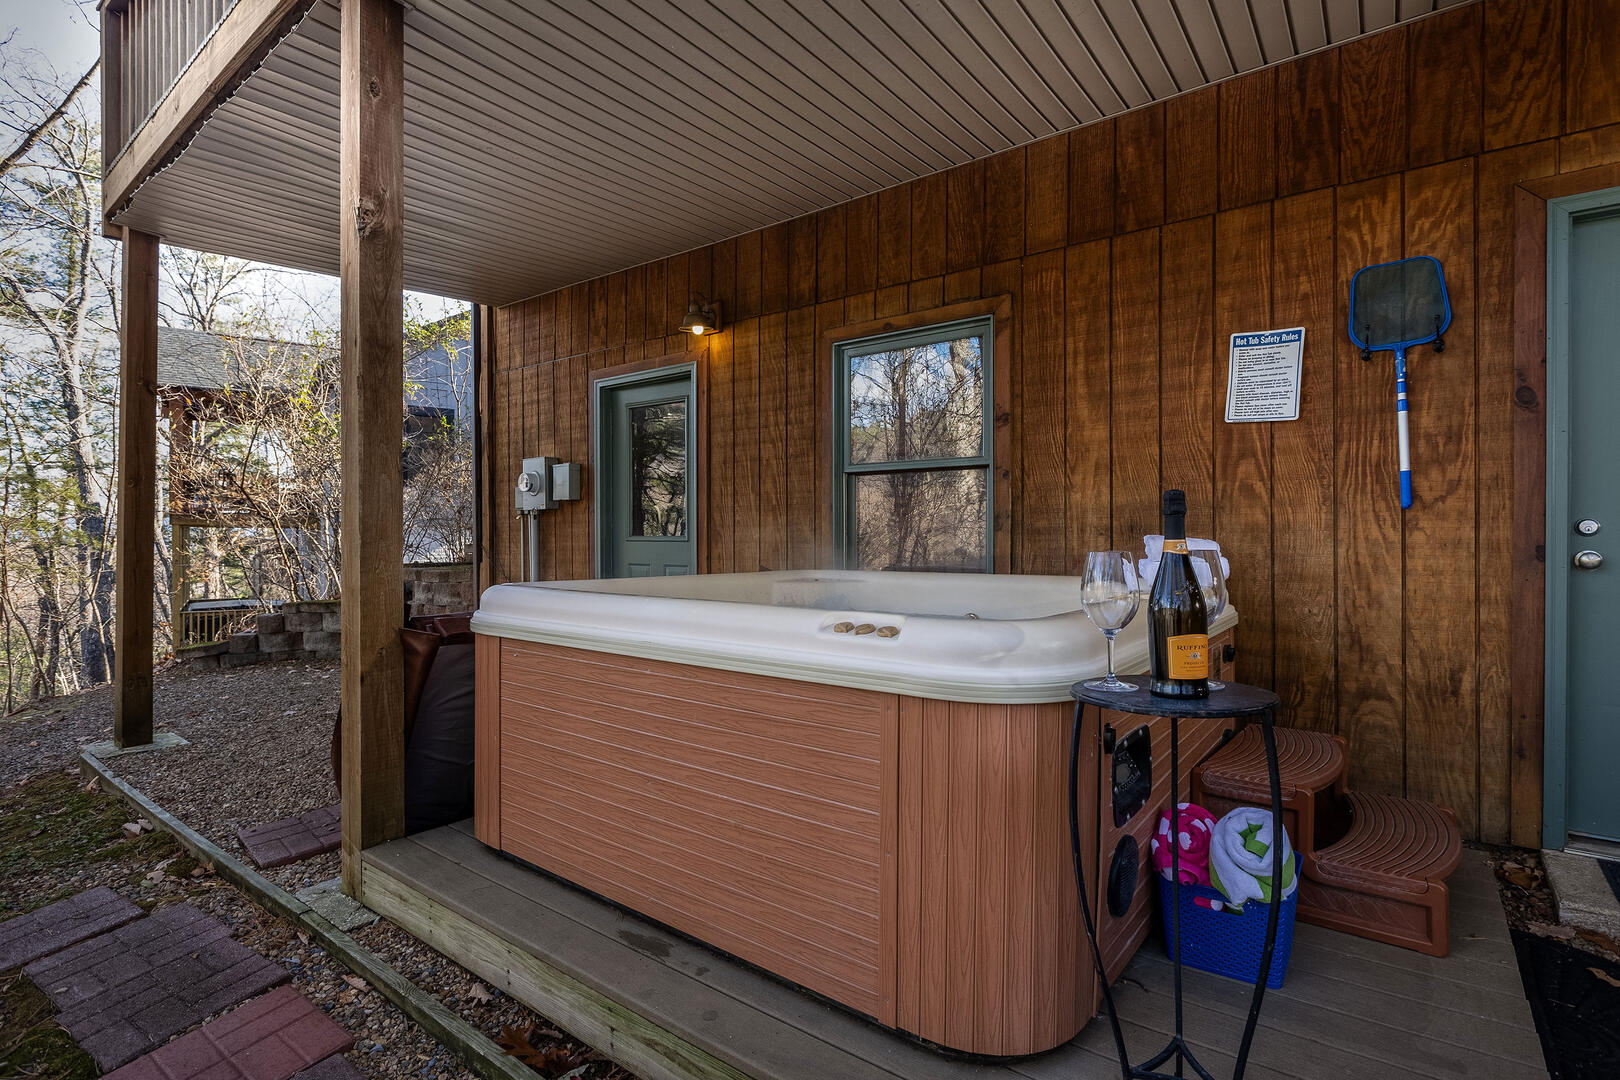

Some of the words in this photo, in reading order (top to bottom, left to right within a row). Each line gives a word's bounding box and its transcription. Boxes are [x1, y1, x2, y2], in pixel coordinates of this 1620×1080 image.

[1236, 338, 1247, 346] Hot
[1248, 337, 1259, 345] Tub
[1260, 336, 1280, 344] Safety
[1281, 333, 1298, 341] Rules
